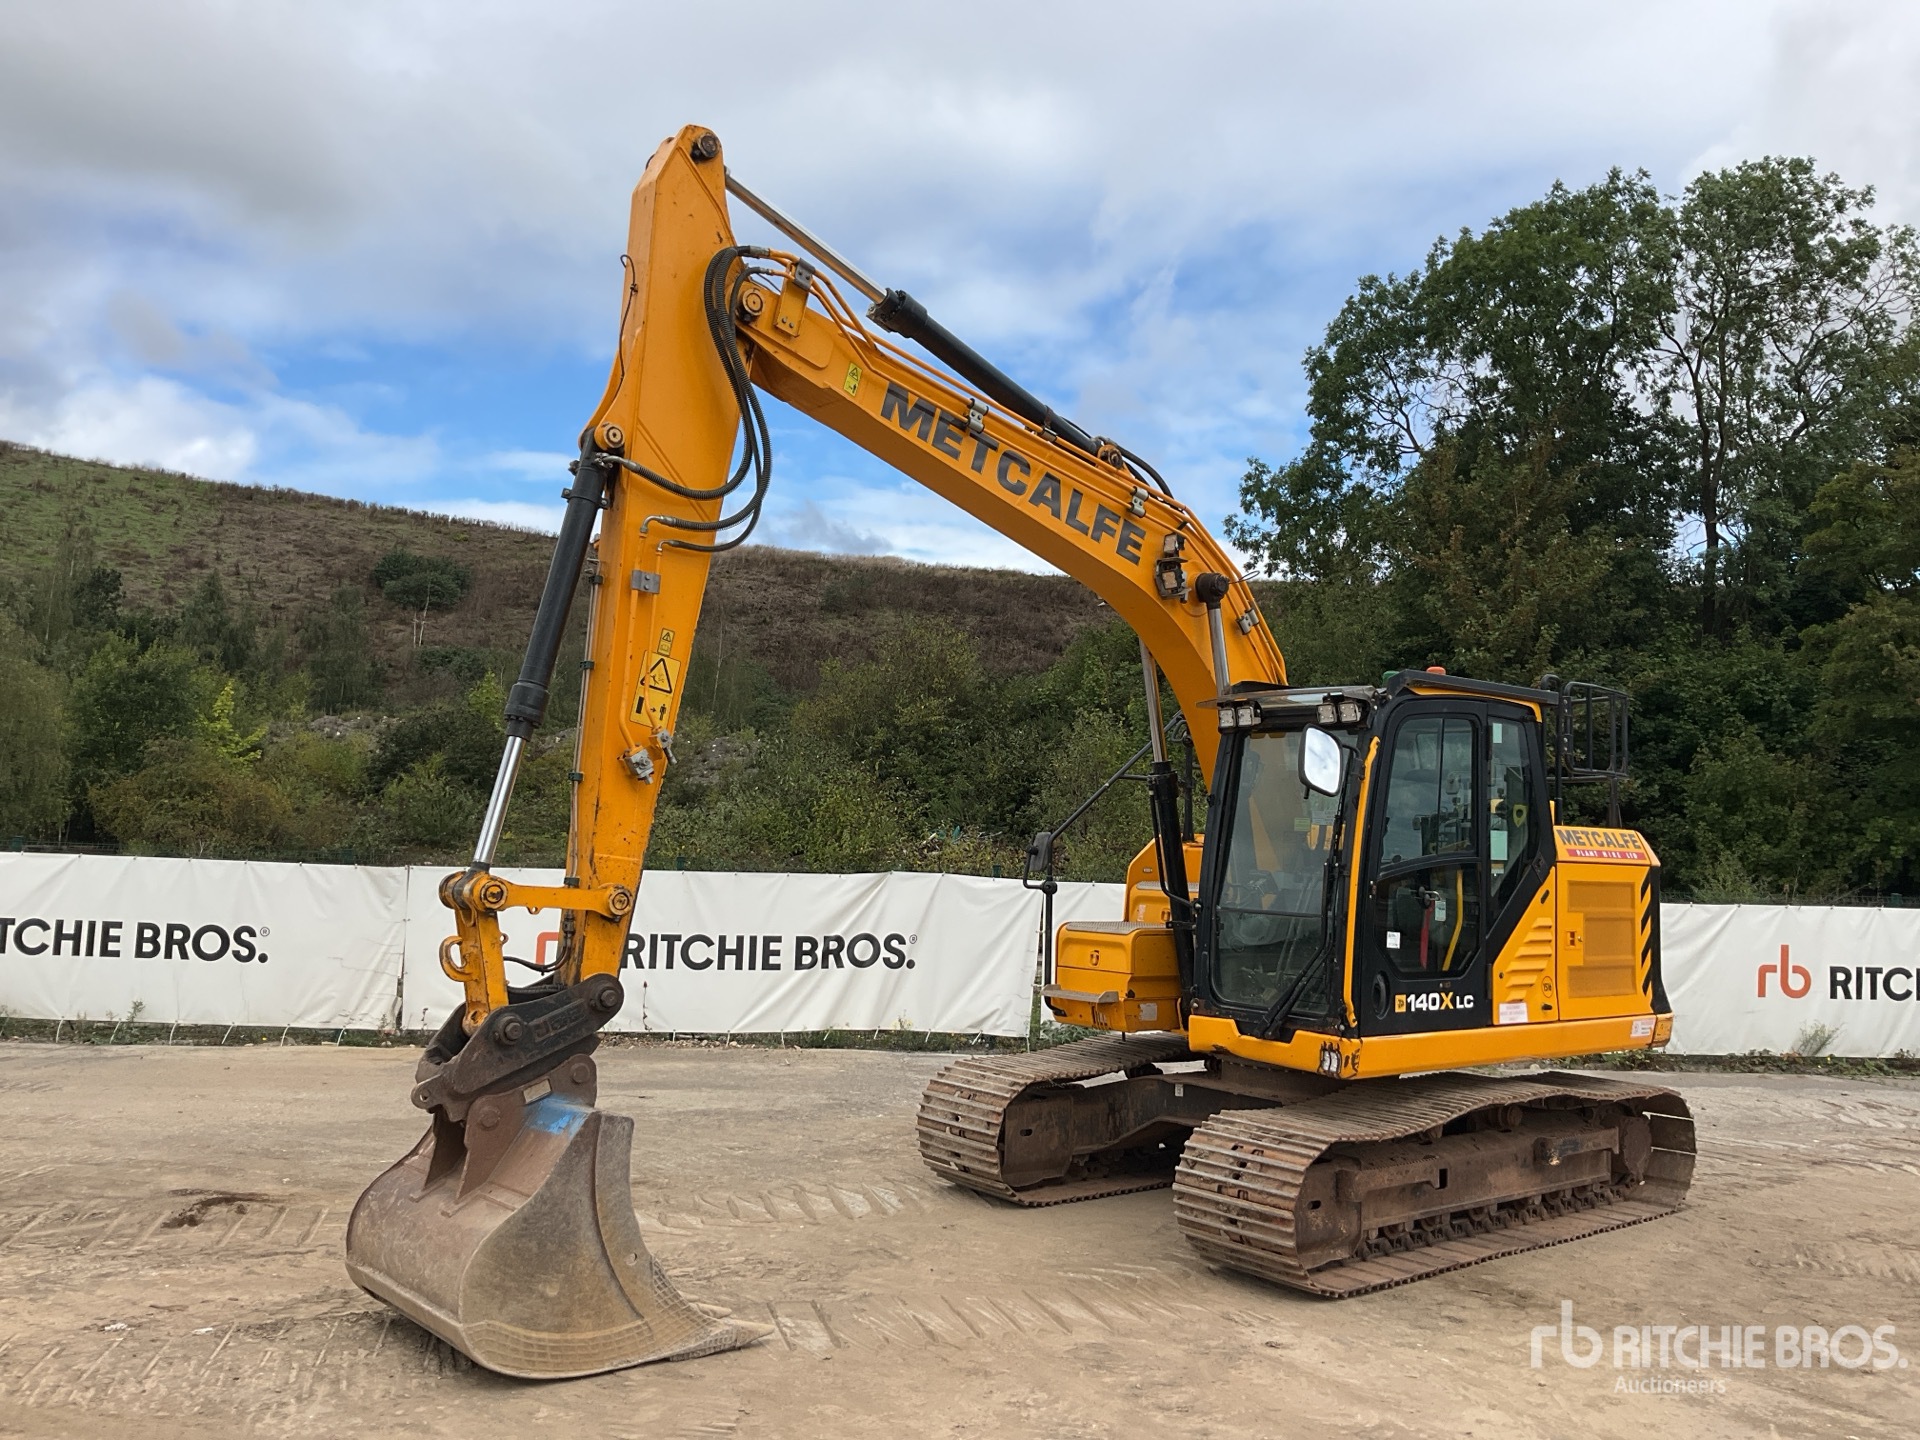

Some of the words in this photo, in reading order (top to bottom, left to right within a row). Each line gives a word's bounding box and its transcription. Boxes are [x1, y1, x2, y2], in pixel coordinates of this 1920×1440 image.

[881, 381, 1147, 566] METCALFE
[1557, 829, 1641, 850] METCALFE
[1576, 849, 1598, 857] PLANT
[621, 932, 782, 971] RITCHIE
[1757, 944, 1812, 999] rb
[1829, 966, 1920, 1002] RITC
